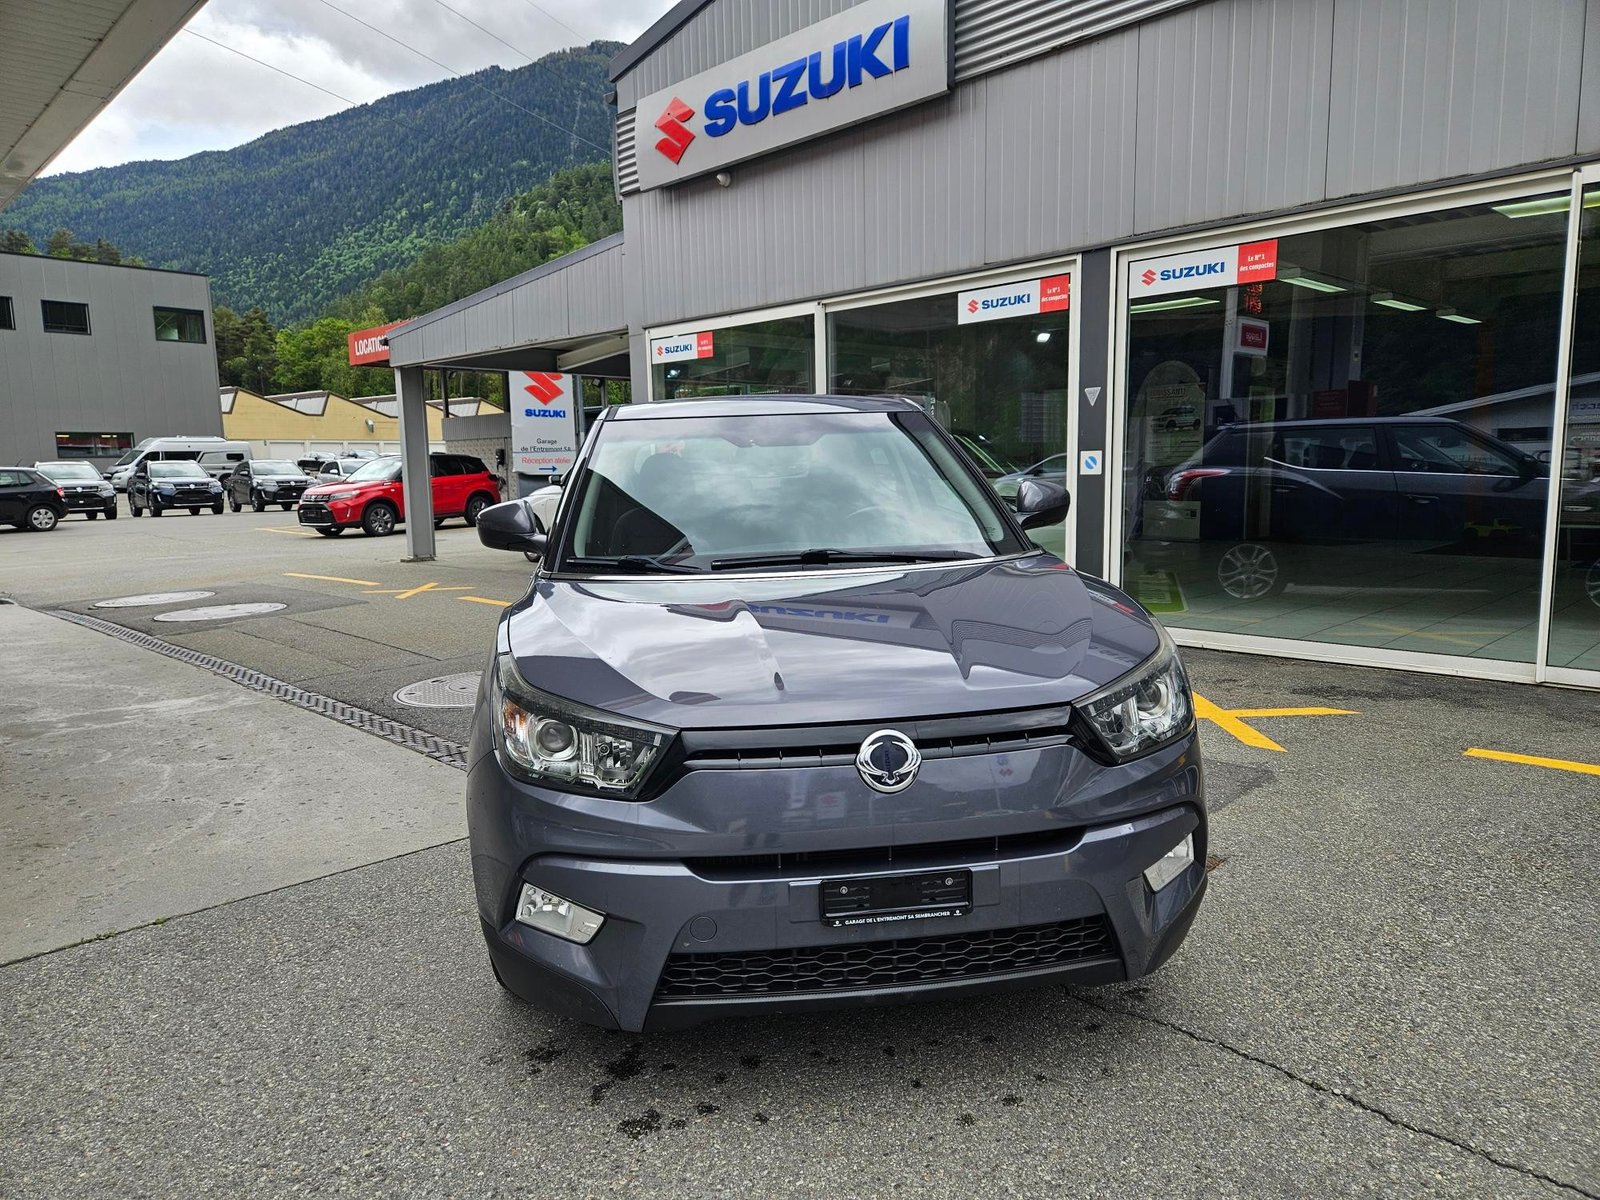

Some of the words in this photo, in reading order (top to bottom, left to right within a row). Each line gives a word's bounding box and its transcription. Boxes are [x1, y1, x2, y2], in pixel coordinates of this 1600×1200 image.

[704, 15, 910, 138] SUZUKI
[1160, 261, 1226, 281] SUZUKI
[1248, 262, 1275, 271] compactes
[981, 293, 1031, 310] SUZUKI
[664, 343, 693, 354] SUZUKI
[525, 409, 566, 418] SUZUKI
[521, 456, 554, 465] Réception
[845, 918, 865, 926] GARAGE
[915, 911, 951, 919] SEMBRANCHER
